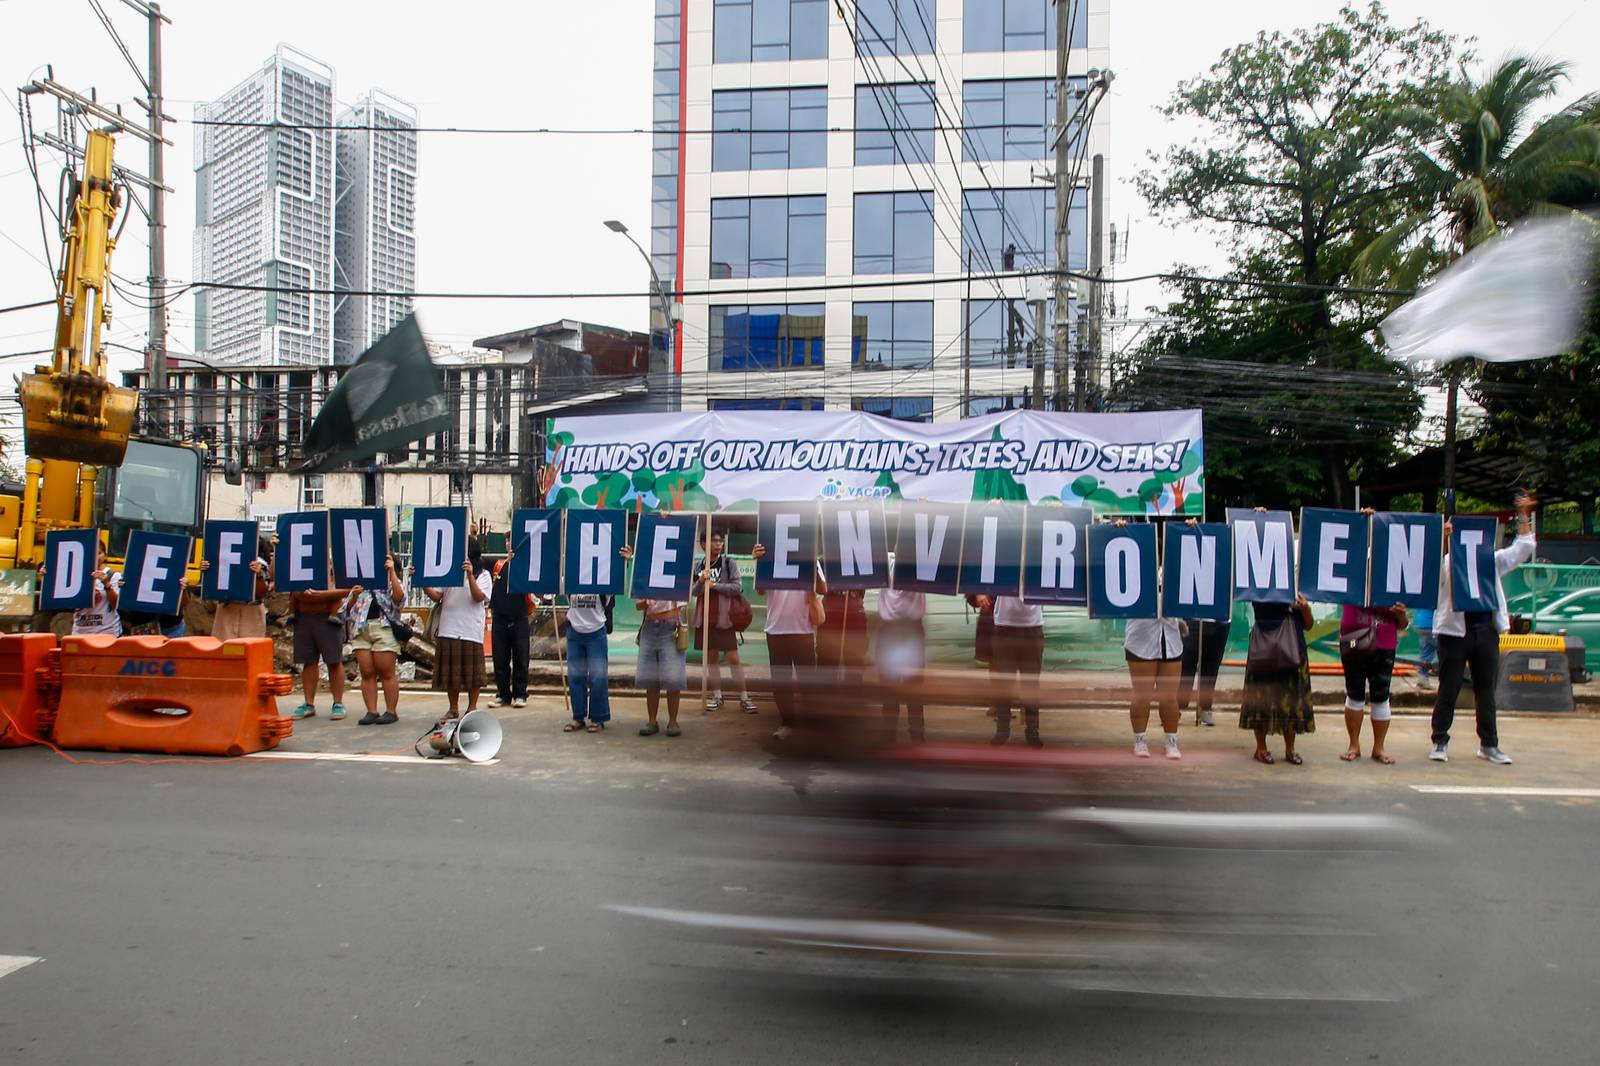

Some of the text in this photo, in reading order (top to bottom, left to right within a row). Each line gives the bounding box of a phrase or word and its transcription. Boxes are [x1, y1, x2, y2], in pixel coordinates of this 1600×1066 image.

[562, 439, 1189, 475] HANDS OFF OUR MOUNTAINS, TREES, AND SEAS!
[848, 487, 891, 497] YACAP
[119, 659, 176, 676] AICC
